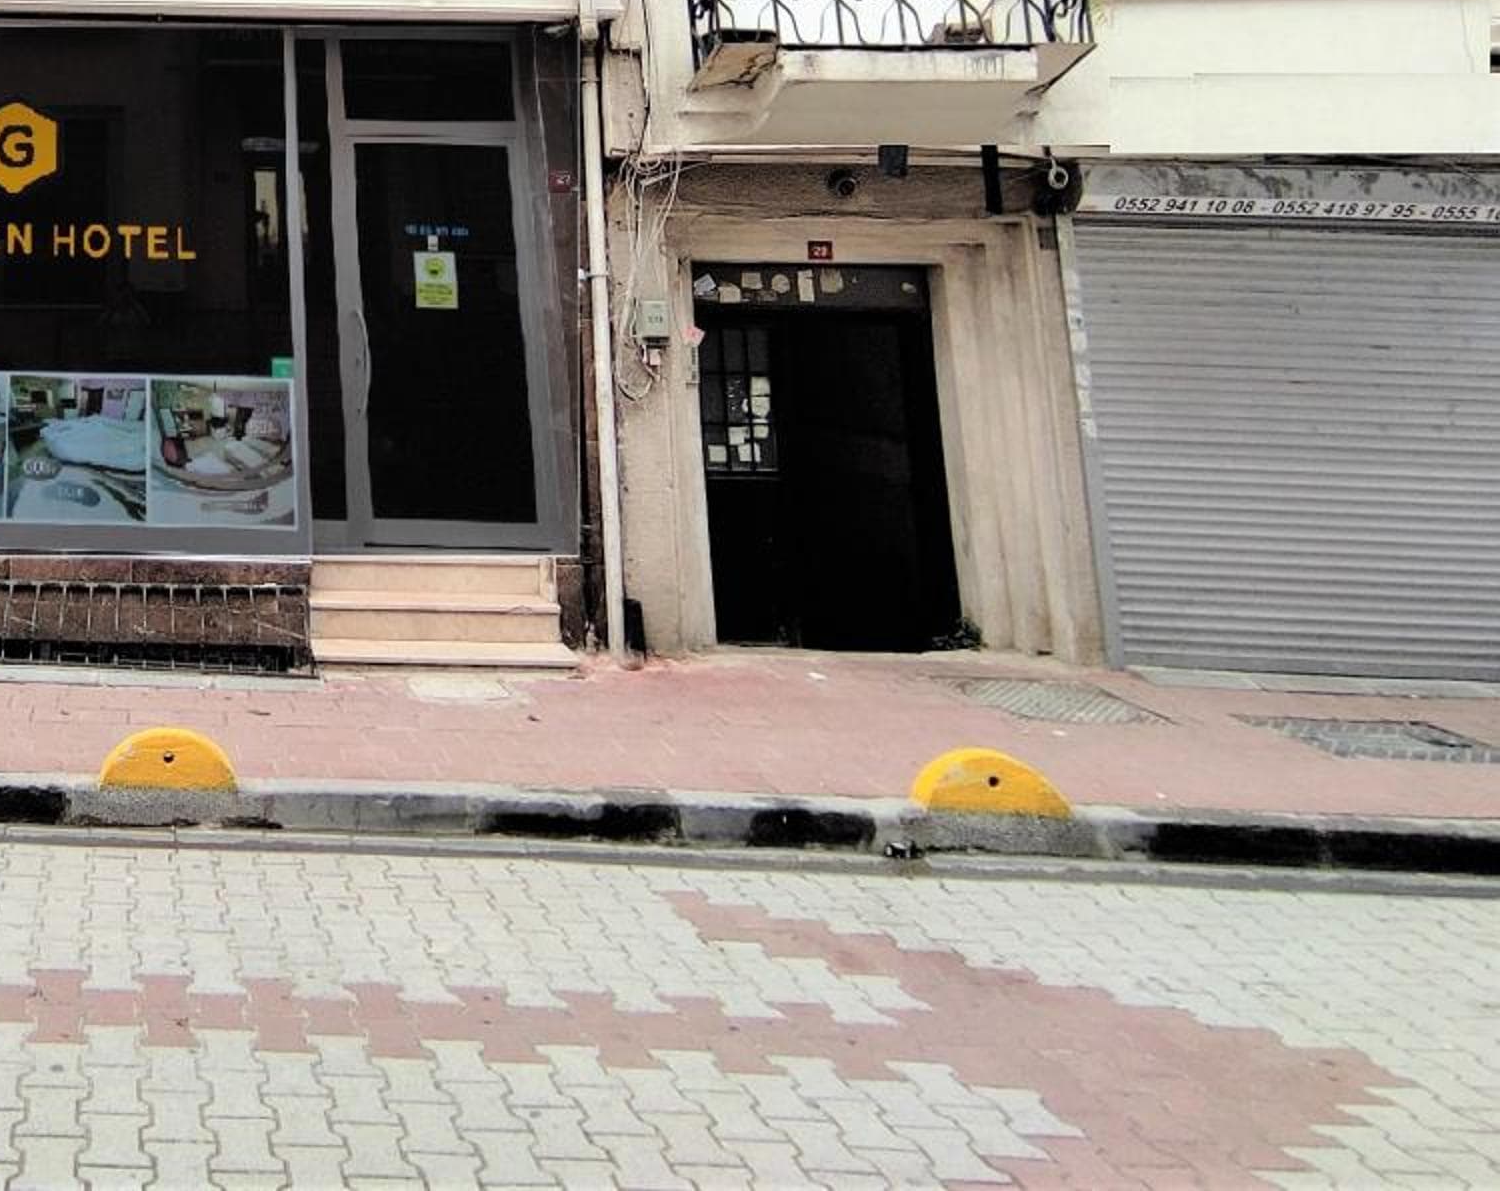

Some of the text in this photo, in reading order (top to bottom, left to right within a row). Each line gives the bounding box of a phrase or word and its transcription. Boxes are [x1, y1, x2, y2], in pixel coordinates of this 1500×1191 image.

[1114, 196, 1160, 212] 0552
[1164, 197, 1200, 213] 941
[1206, 199, 1228, 214] 10
[1273, 200, 1320, 215] 0552
[1323, 201, 1359, 217] 418
[1363, 202, 1389, 217] 97
[1391, 203, 1417, 218] 95
[1432, 205, 1478, 220] 0555
[52, 223, 197, 260] HOTEL
